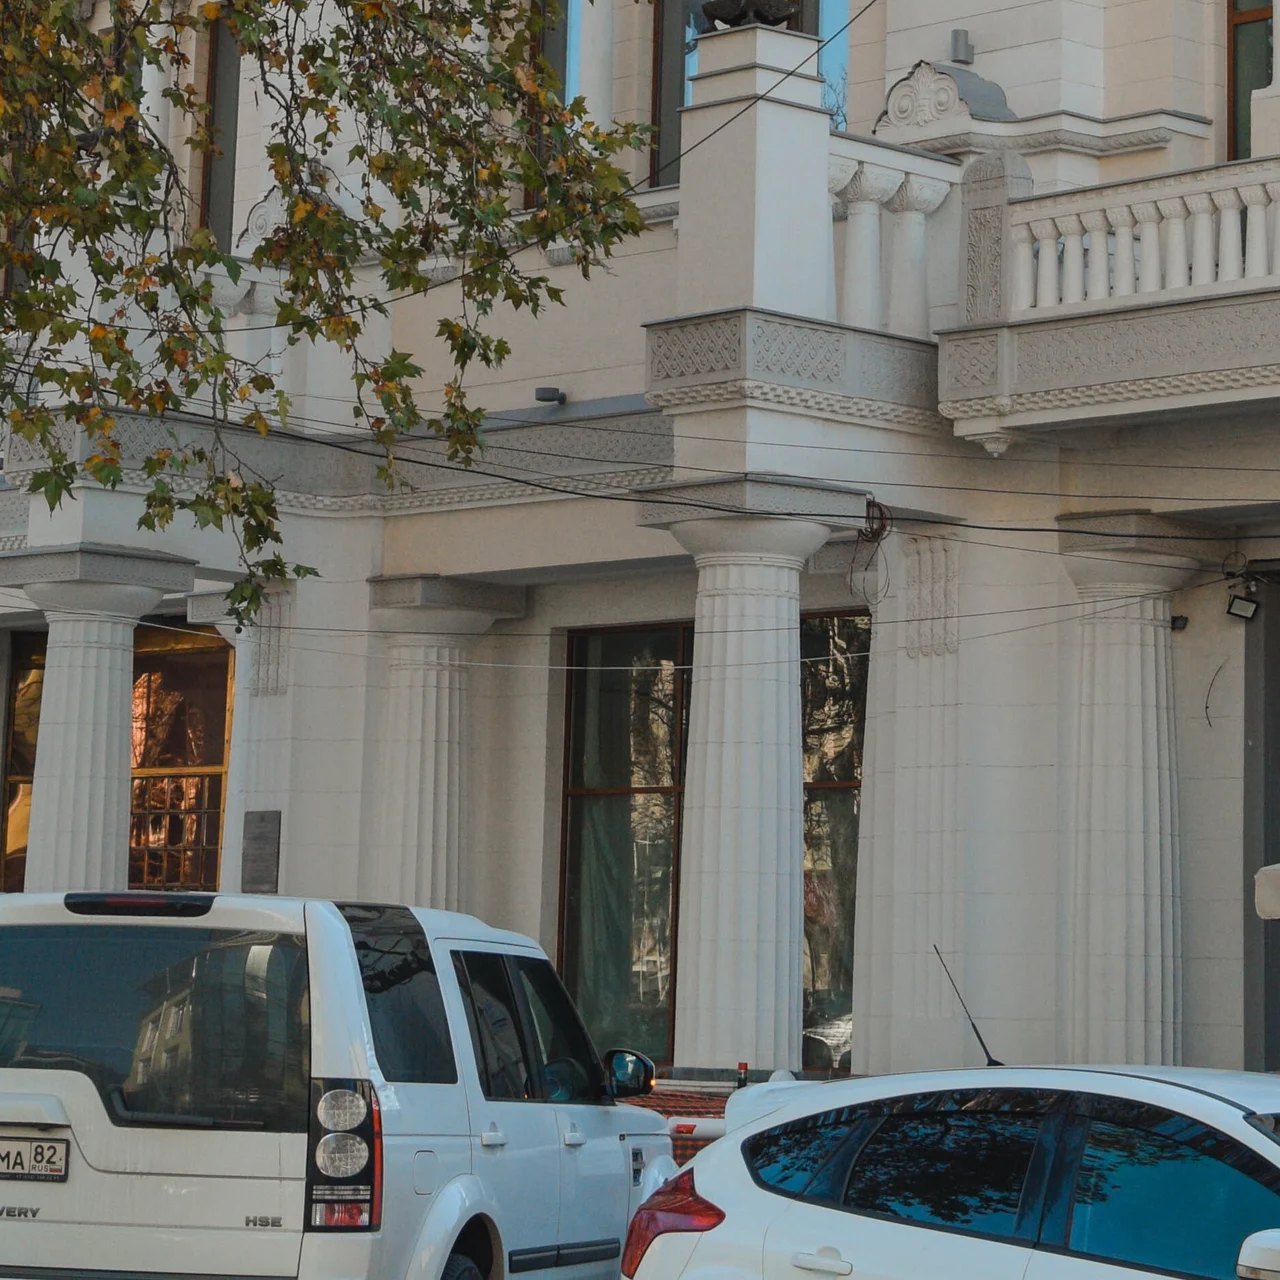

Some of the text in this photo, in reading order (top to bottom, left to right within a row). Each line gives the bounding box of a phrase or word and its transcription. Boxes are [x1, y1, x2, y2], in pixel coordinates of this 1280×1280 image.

[33, 1144, 57, 1165] 82
[31, 1164, 49, 1173] RUS
[244, 1215, 282, 1228] HSE
